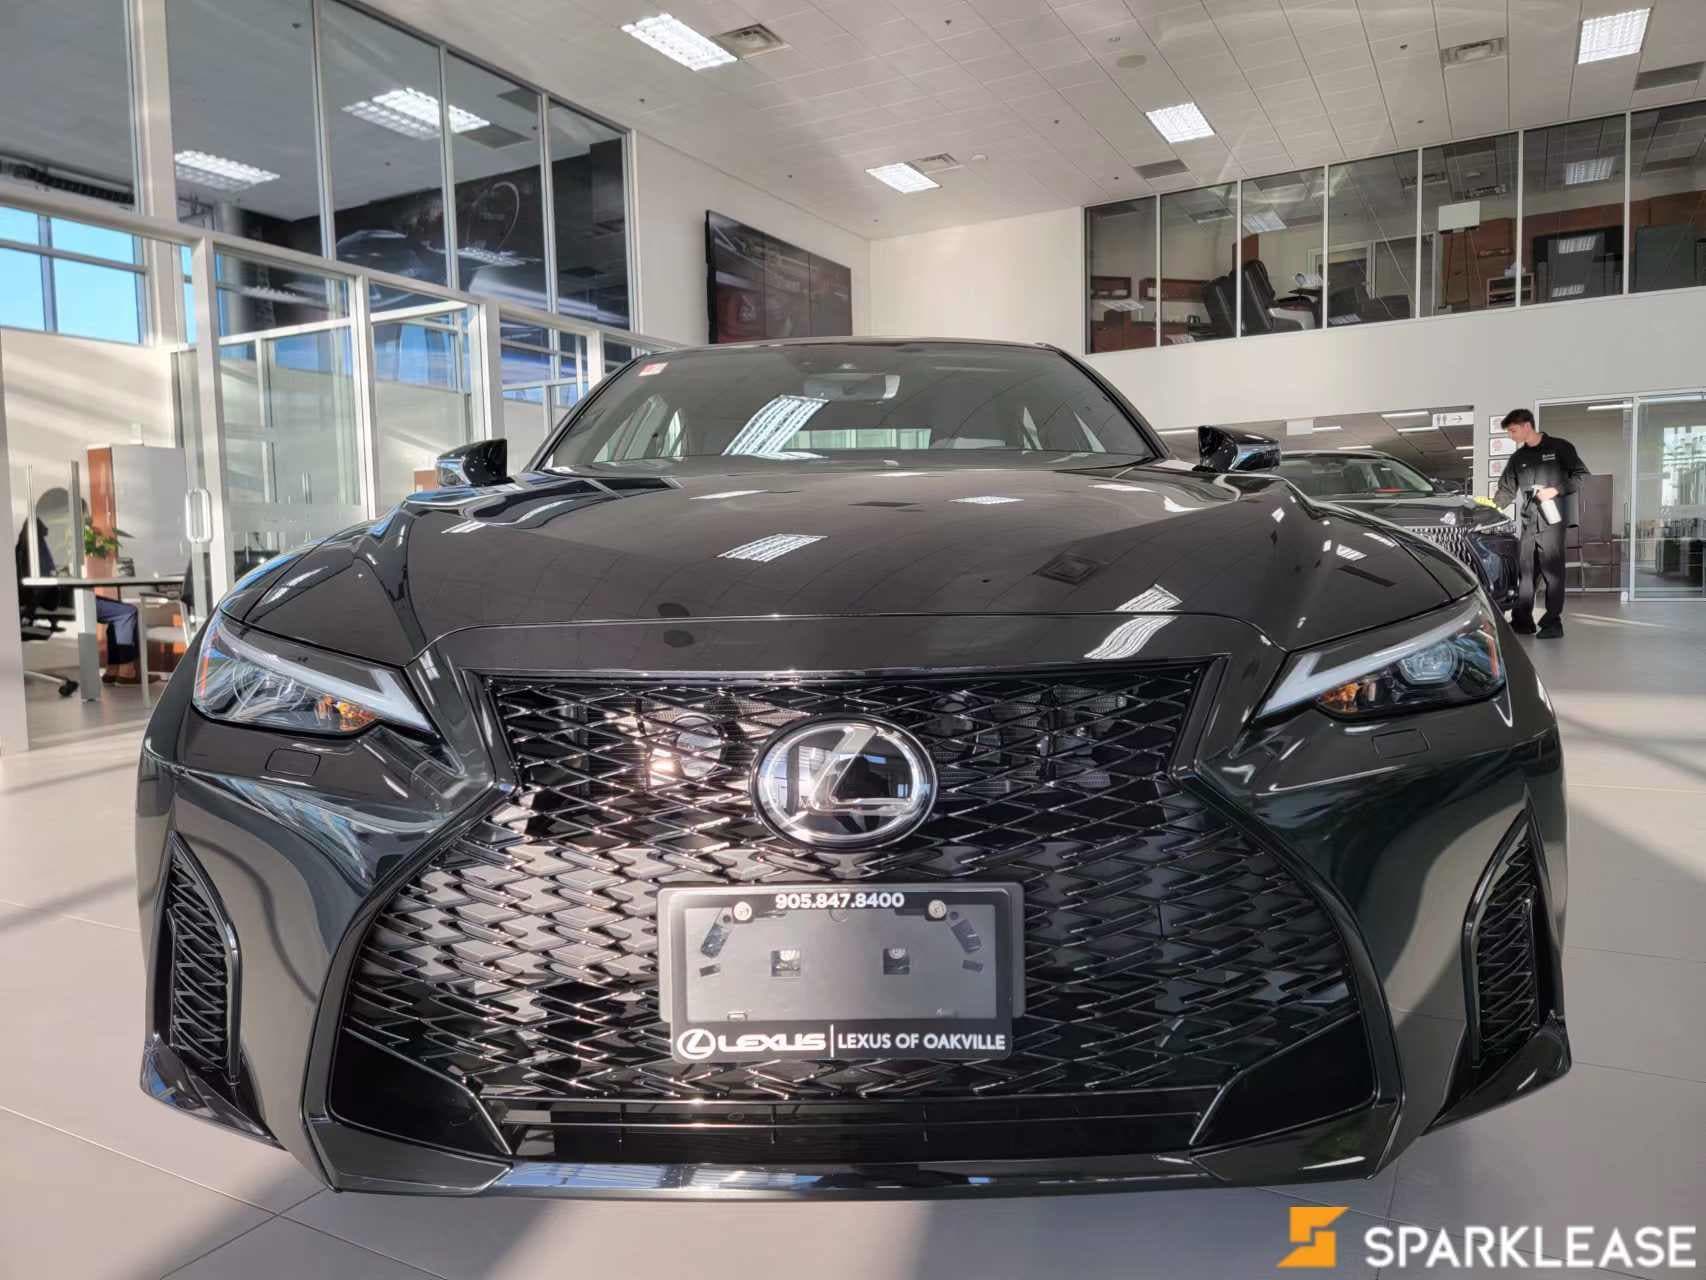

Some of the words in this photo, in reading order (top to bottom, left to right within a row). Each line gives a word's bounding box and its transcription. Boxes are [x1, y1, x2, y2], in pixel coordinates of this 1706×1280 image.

[775, 892, 905, 909] 905.847.8400
[717, 1033, 827, 1052] LEXUS
[837, 1033, 892, 1049] LEXUS
[895, 1033, 920, 1049] OF
[923, 1034, 1006, 1050] OAKVILLE
